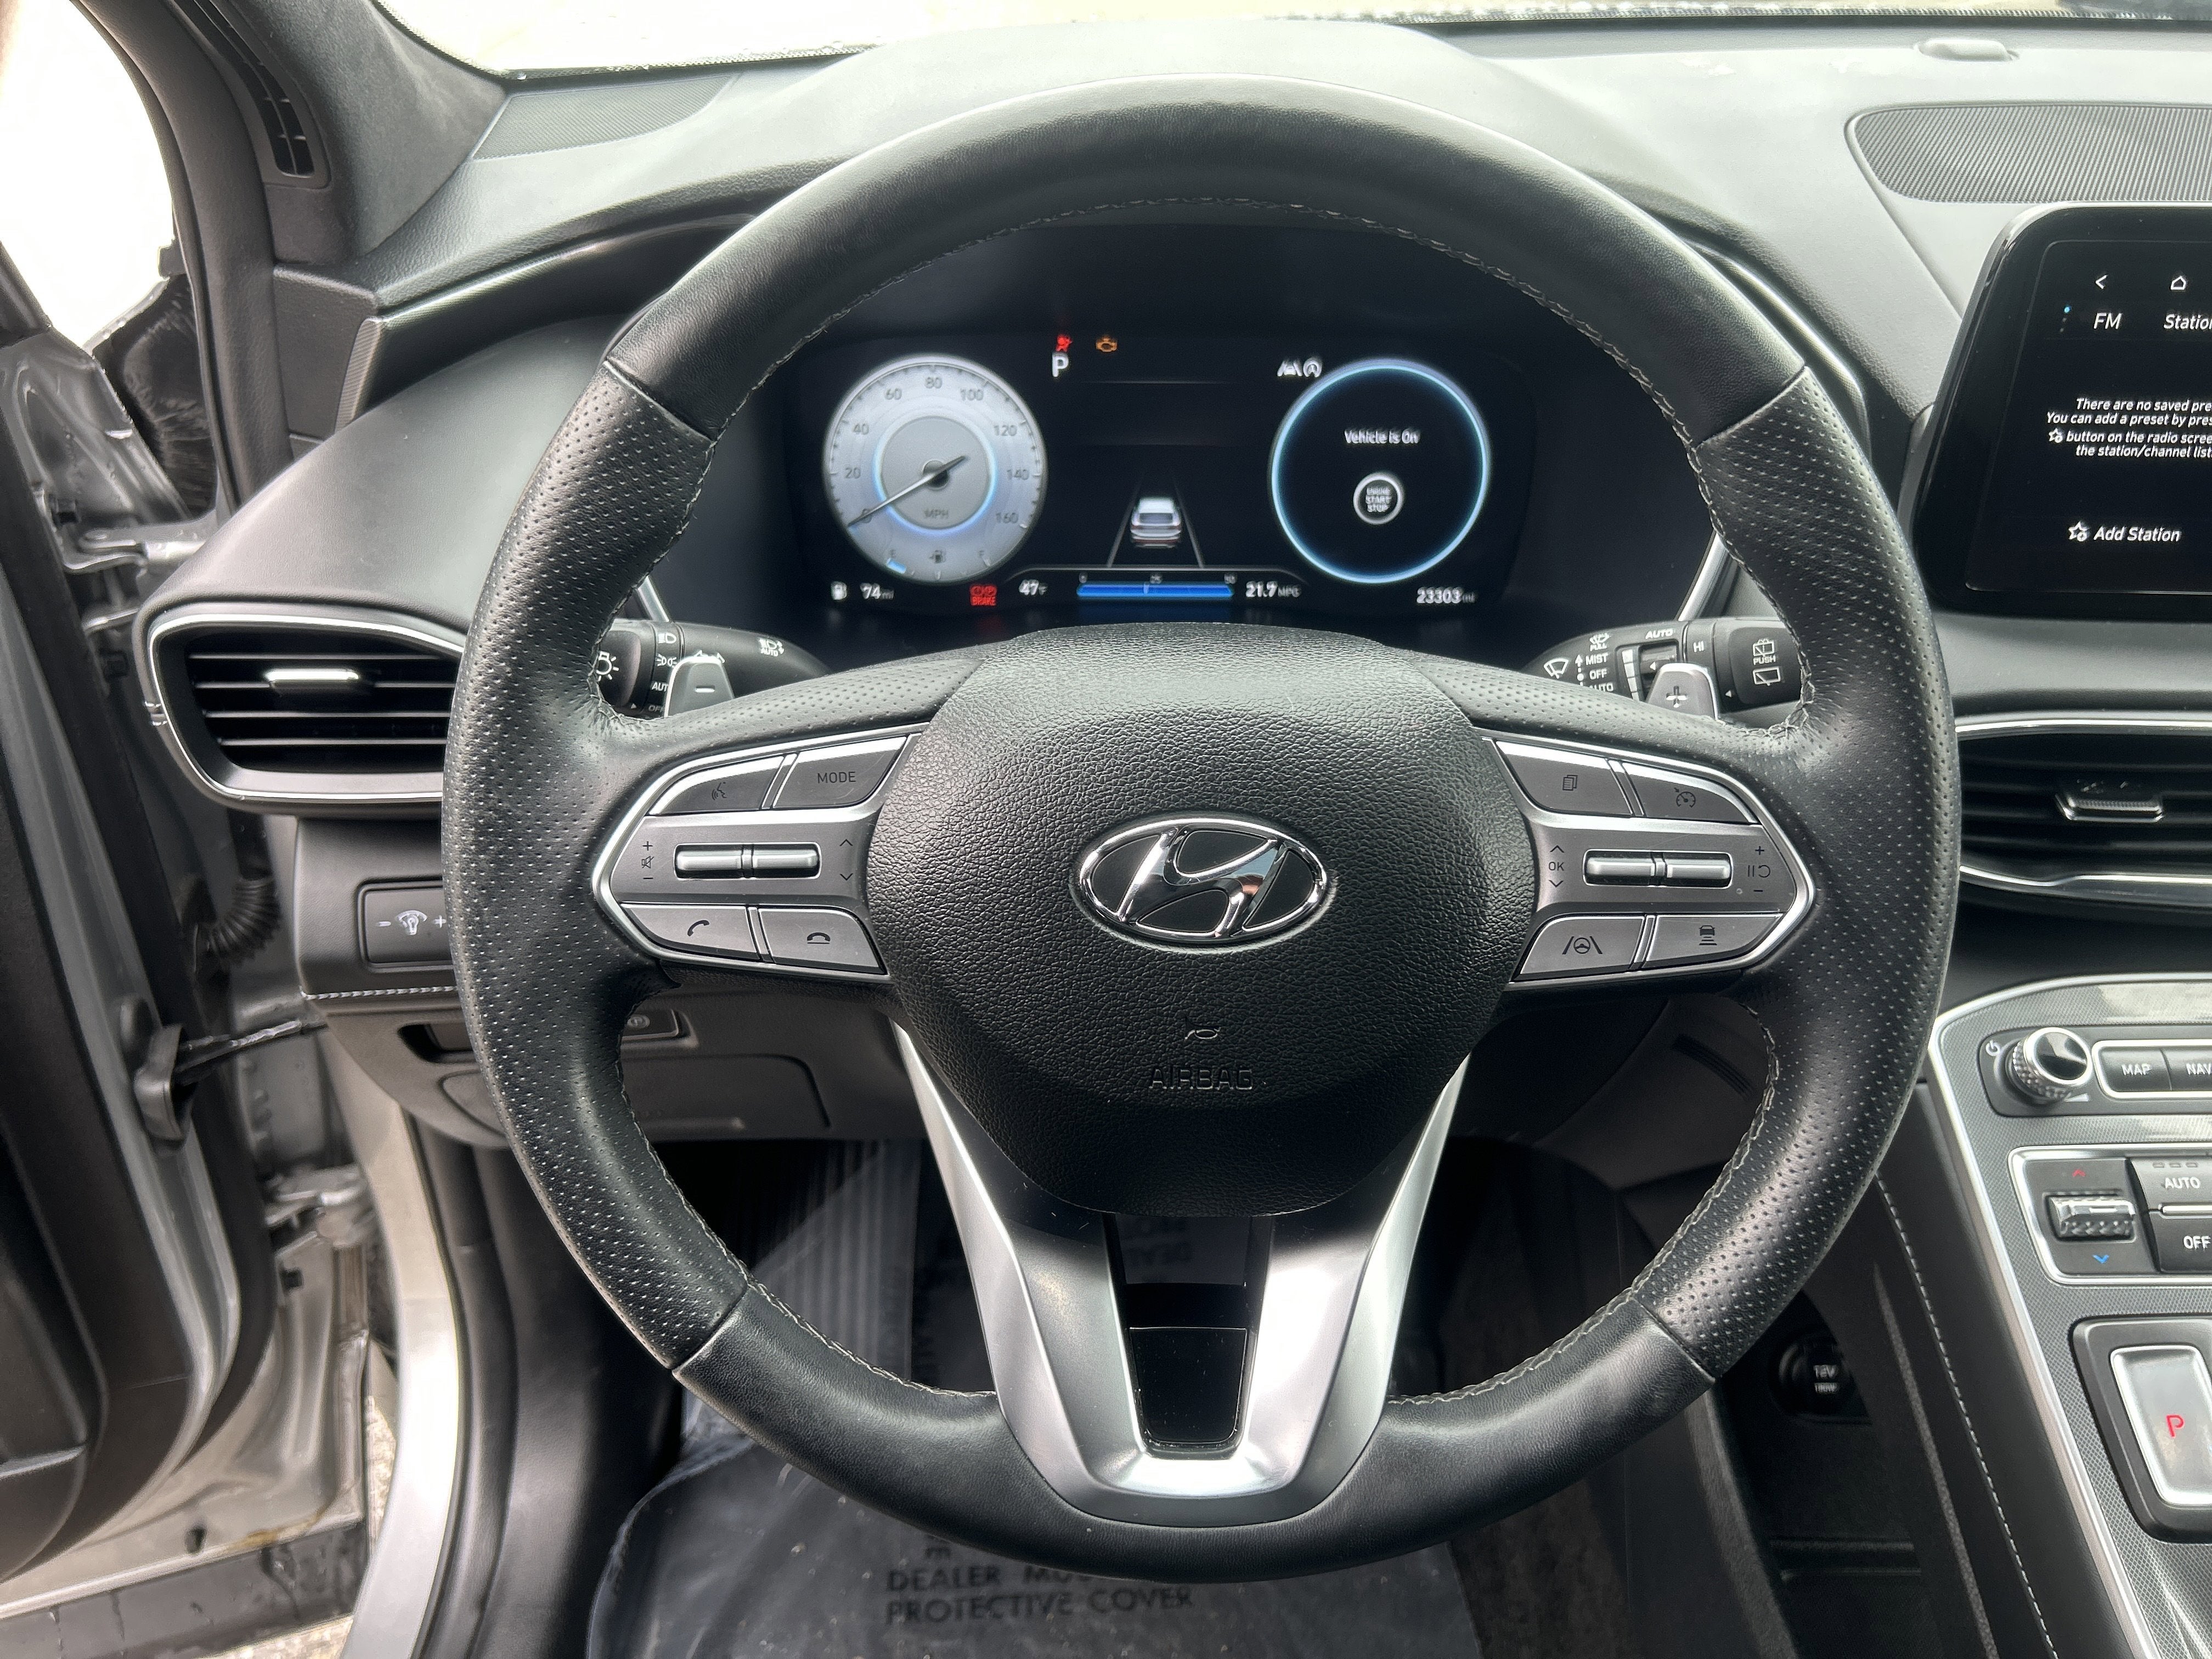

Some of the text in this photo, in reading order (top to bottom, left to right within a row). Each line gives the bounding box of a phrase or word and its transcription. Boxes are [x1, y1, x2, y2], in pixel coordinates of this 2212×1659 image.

[2093, 313, 2123, 329] FM
[1052, 352, 1069, 377] P
[925, 376, 943, 389] 80
[884, 388, 902, 400] 60
[960, 388, 984, 401] 100
[2076, 398, 2212, 414] There are no saved pre
[2047, 411, 2067, 424] You
[2070, 414, 2092, 424] can
[2095, 413, 2118, 425] add
[2119, 415, 2128, 425] a
[2129, 414, 2169, 427] preset
[2171, 414, 2186, 428] by
[853, 423, 870, 435] 40
[994, 425, 1017, 437] 120
[1344, 427, 1421, 444] Vehicle is On
[2066, 430, 2104, 443] button
[2107, 432, 2122, 443] on
[2125, 431, 2145, 443] the
[2147, 432, 2178, 444] radio
[2076, 444, 2095, 456] the
[2097, 444, 2191, 458] station/channel
[844, 467, 861, 479] 20
[1007, 469, 1030, 481] 140
[1365, 495, 1392, 504] START
[996, 512, 1019, 524] 160
[2093, 526, 2181, 542] Add Station
[1417, 586, 1463, 604] 23303
[1645, 628, 1673, 640] AUTO
[760, 647, 779, 657] AUTO
[1693, 640, 1705, 653] HI
[1585, 652, 1609, 665] MIST
[1753, 654, 1776, 665] PUSH
[1589, 668, 1607, 680] OFF
[651, 681, 669, 692] AUT
[816, 771, 856, 783] MODE
[1548, 861, 1565, 872] OK
[2121, 1063, 2151, 1076] MAP
[2185, 1063, 2212, 1076] NAV
[1150, 1068, 1253, 1091] AIRBAG
[2164, 1177, 2200, 1189] AUTO
[2183, 1235, 2211, 1250] OFF
[2165, 1414, 2185, 1437] P
[887, 1565, 1002, 1592] DEALER
[885, 1587, 1194, 1625] PROTECTIVE COVER
